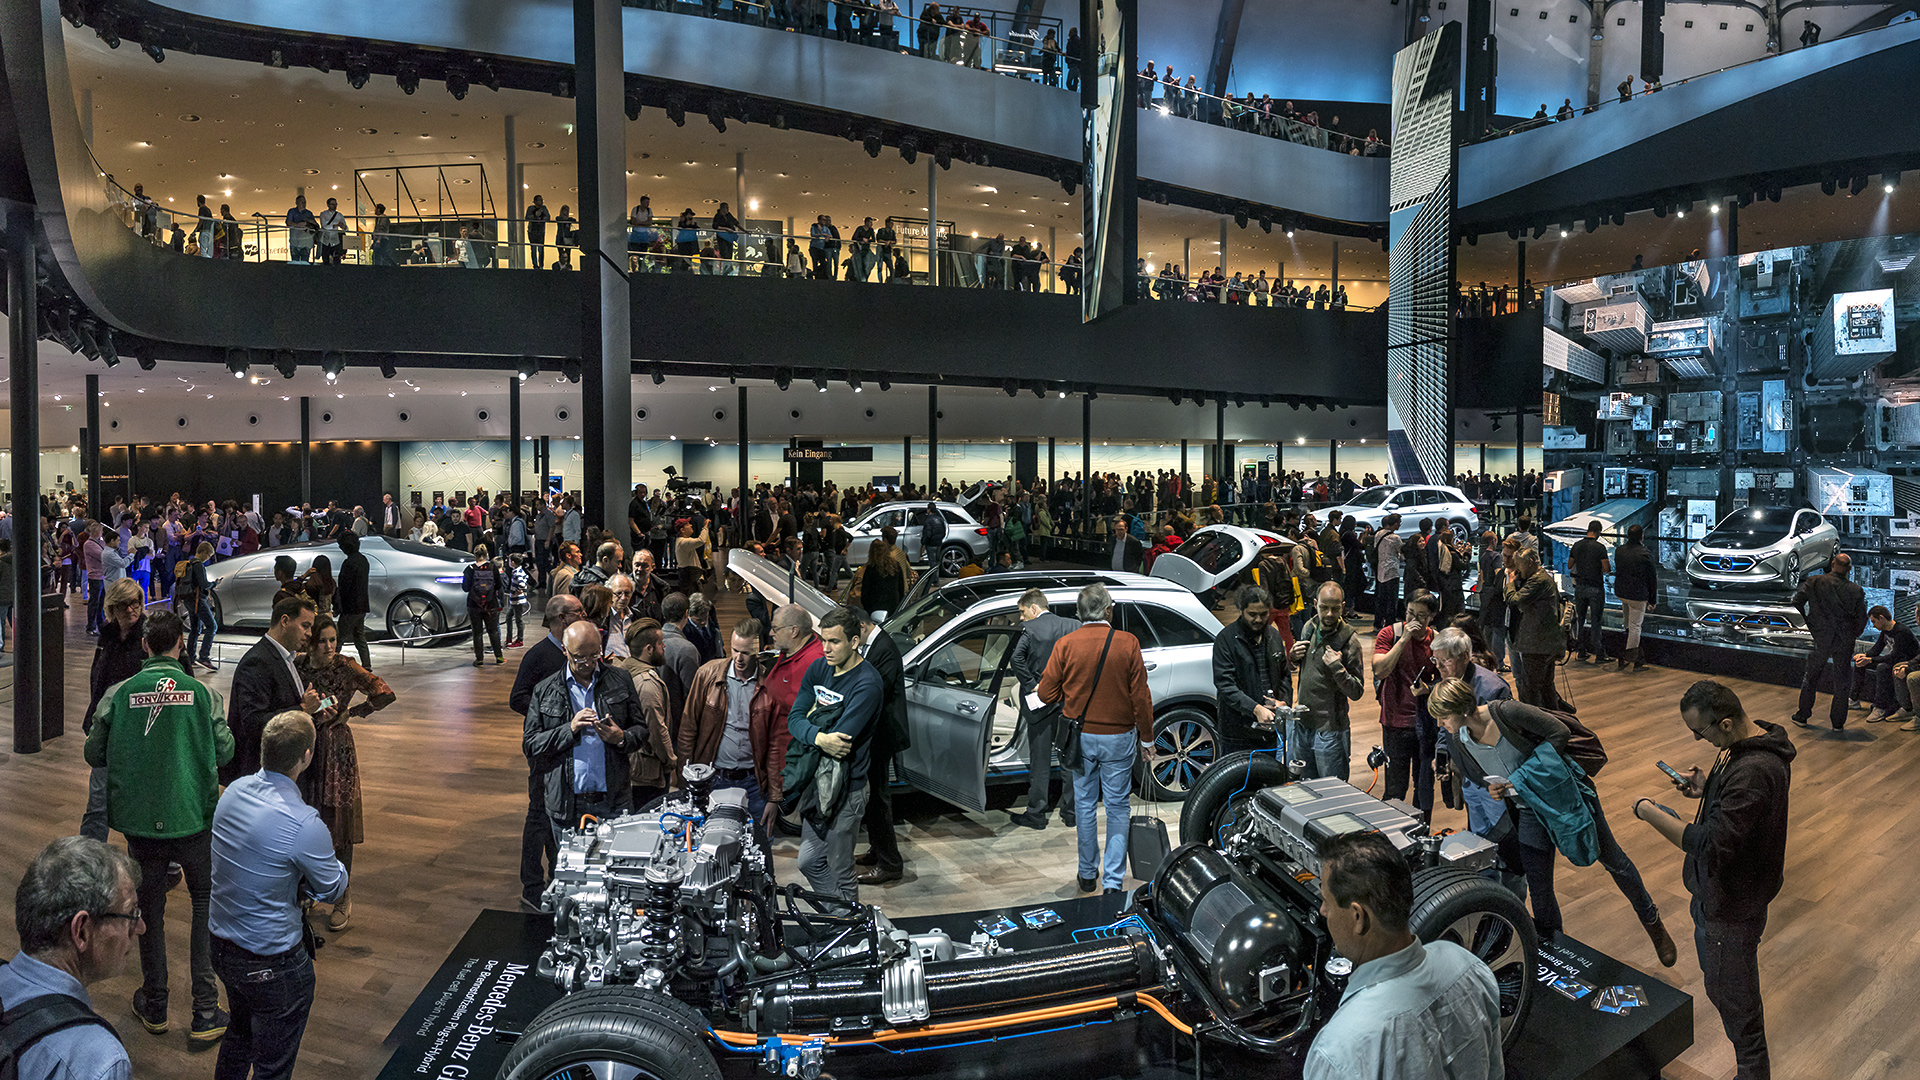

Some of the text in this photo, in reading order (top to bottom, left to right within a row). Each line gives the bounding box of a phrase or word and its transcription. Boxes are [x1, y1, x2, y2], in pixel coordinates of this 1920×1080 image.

[896, 225, 920, 236] Future
[788, 449, 803, 458] Kein
[804, 449, 833, 460] Eingang
[131, 692, 192, 704] TONY KART
[1558, 948, 1578, 962] fuel
[484, 960, 499, 972] Der
[1577, 956, 1593, 969] The
[1562, 965, 1580, 976] Der
[416, 957, 480, 1037] The fuel cell plug-in hybrid
[451, 971, 492, 1021] Brennstoffzellen
[451, 962, 530, 1061] Mercedes-Benz
